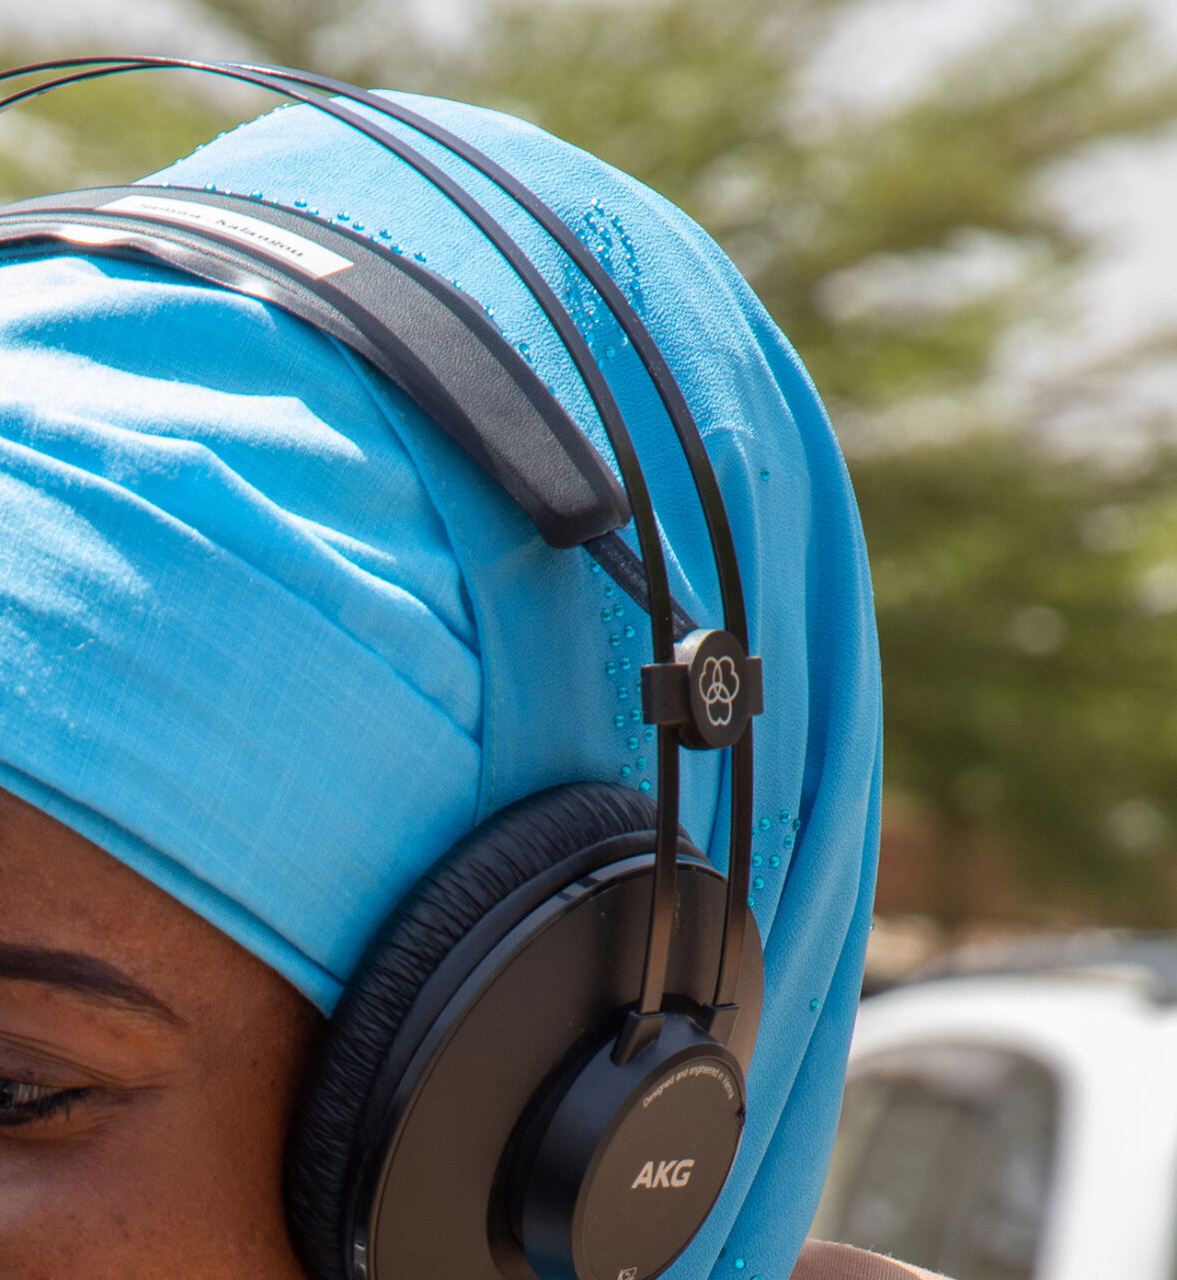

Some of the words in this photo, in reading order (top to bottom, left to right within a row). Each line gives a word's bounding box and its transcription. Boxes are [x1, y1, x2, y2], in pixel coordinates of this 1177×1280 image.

[642, 1074, 675, 1107] Designed
[676, 1068, 689, 1081] and
[689, 1065, 720, 1078] engineered
[631, 1159, 695, 1189] AKG
